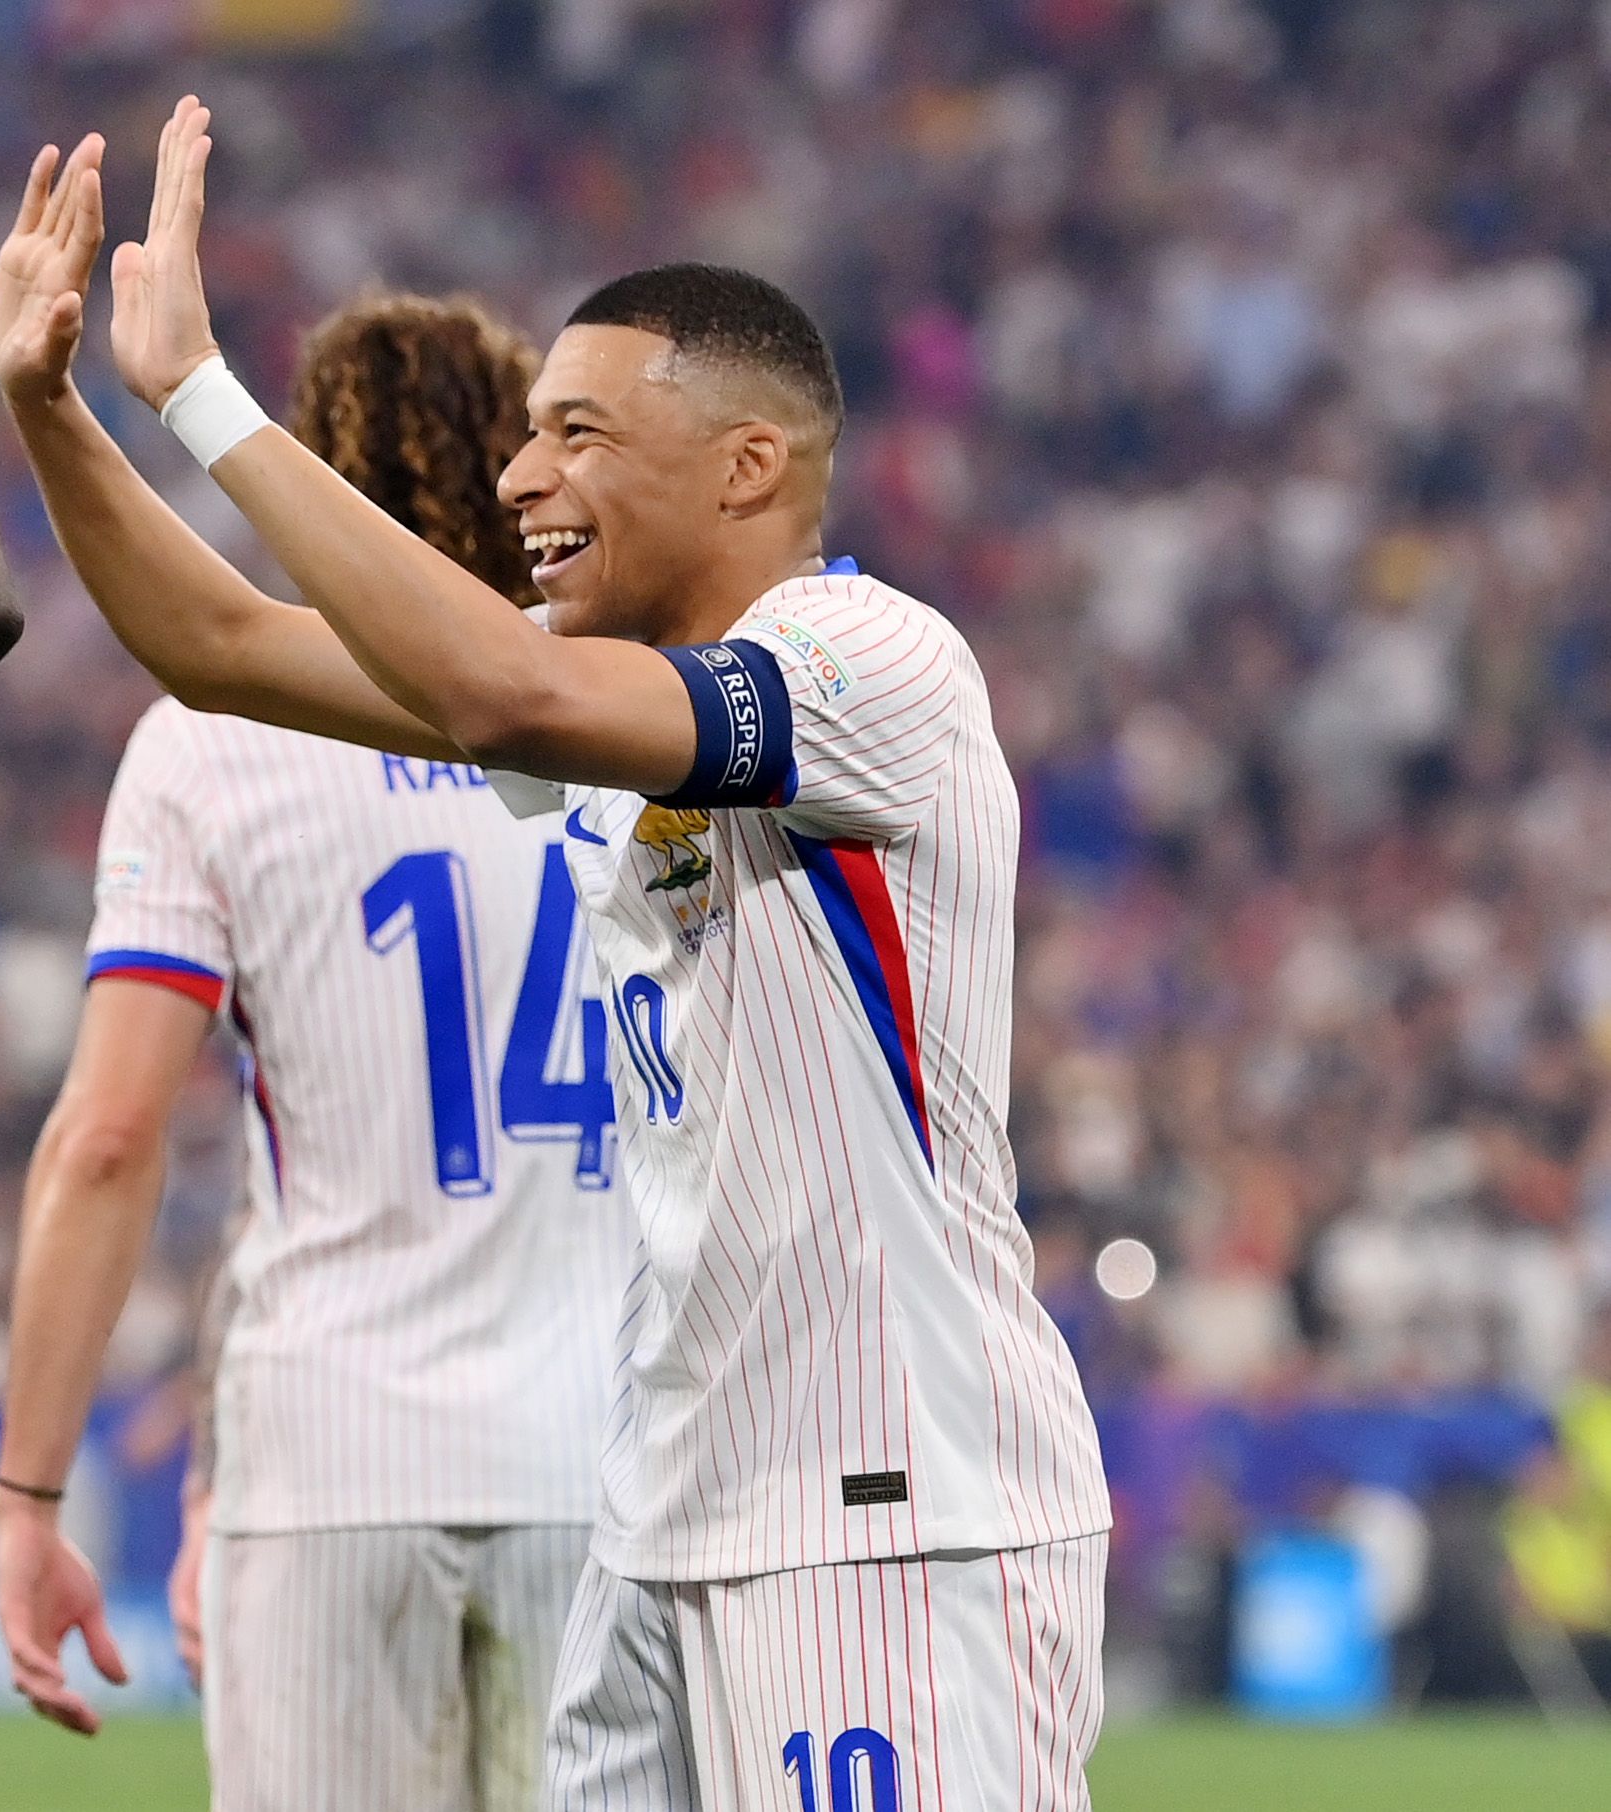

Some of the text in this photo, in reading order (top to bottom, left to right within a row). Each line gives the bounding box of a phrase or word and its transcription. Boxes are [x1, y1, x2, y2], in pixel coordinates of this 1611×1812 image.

[722, 672, 757, 787] RESPECT
[361, 843, 618, 1198] 14
[612, 973, 684, 1127] 10
